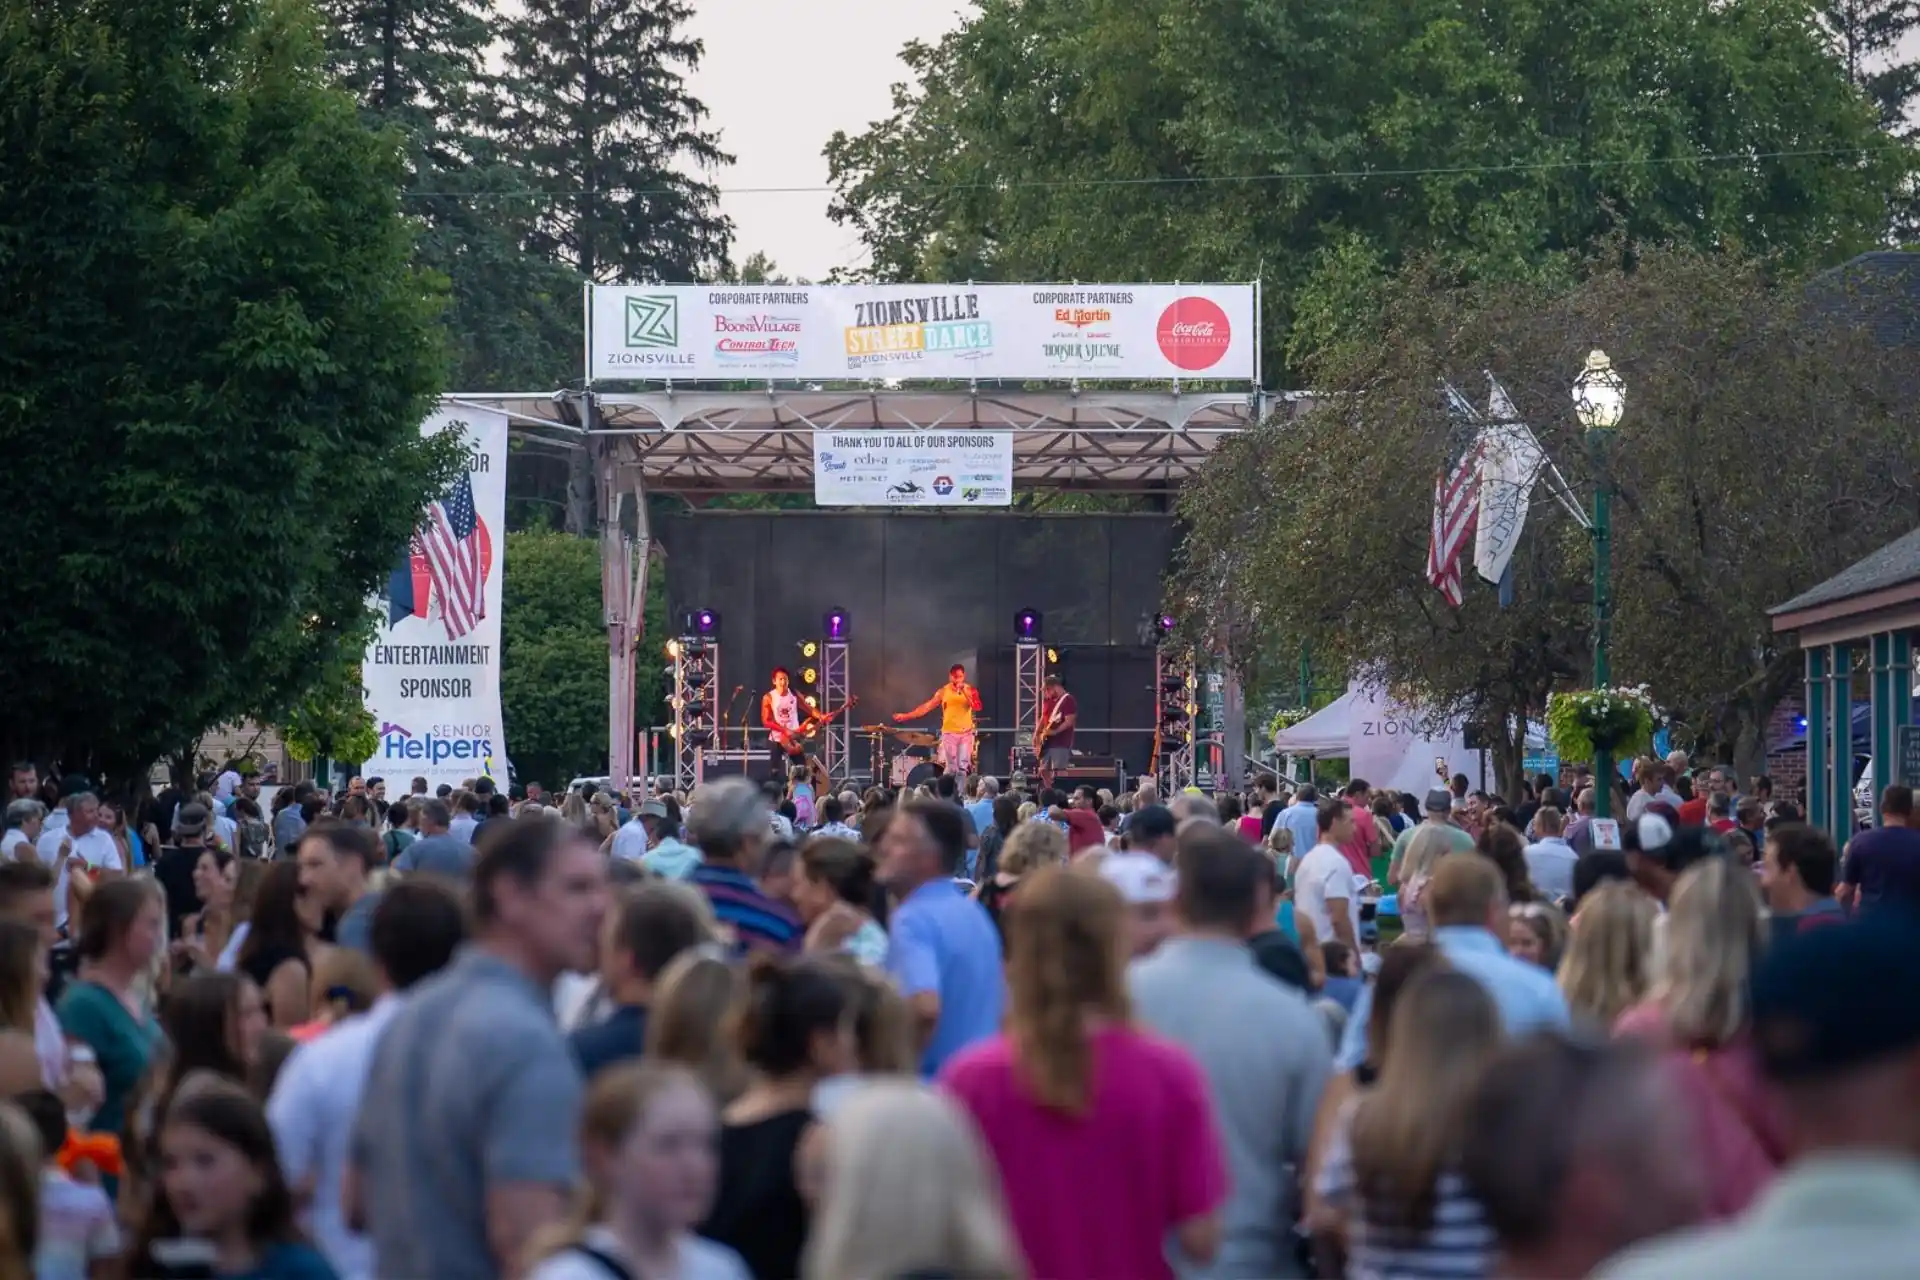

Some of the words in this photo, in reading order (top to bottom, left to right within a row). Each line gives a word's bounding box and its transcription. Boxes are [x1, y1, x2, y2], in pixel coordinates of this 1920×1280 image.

[709, 292, 761, 305] CORPORATE
[763, 292, 809, 305] PARTNERS
[1033, 292, 1085, 304] CORPORATE
[1087, 292, 1133, 304] PARTNERS
[855, 294, 979, 328] ZIONSVILLE
[1055, 308, 1070, 321] Ed
[1074, 308, 1111, 321] Martin
[849, 326, 921, 353] STREET
[923, 324, 990, 349] DANCE
[608, 353, 697, 364] ZIONSVILLE
[862, 351, 924, 364] ZIONSVILLE
[832, 436, 862, 448] THANK
[863, 436, 882, 448] YOU
[884, 436, 895, 448] TO
[896, 436, 912, 448] ALL
[914, 436, 925, 448] OF
[927, 436, 945, 448] OUR
[947, 436, 994, 448] SPONSORS
[375, 645, 490, 665] ENTERTAINMENT
[400, 678, 472, 698] SPONSOR
[432, 724, 492, 738] SENIOR
[1361, 718, 1415, 736] ZION
[385, 733, 493, 765] Helpers
